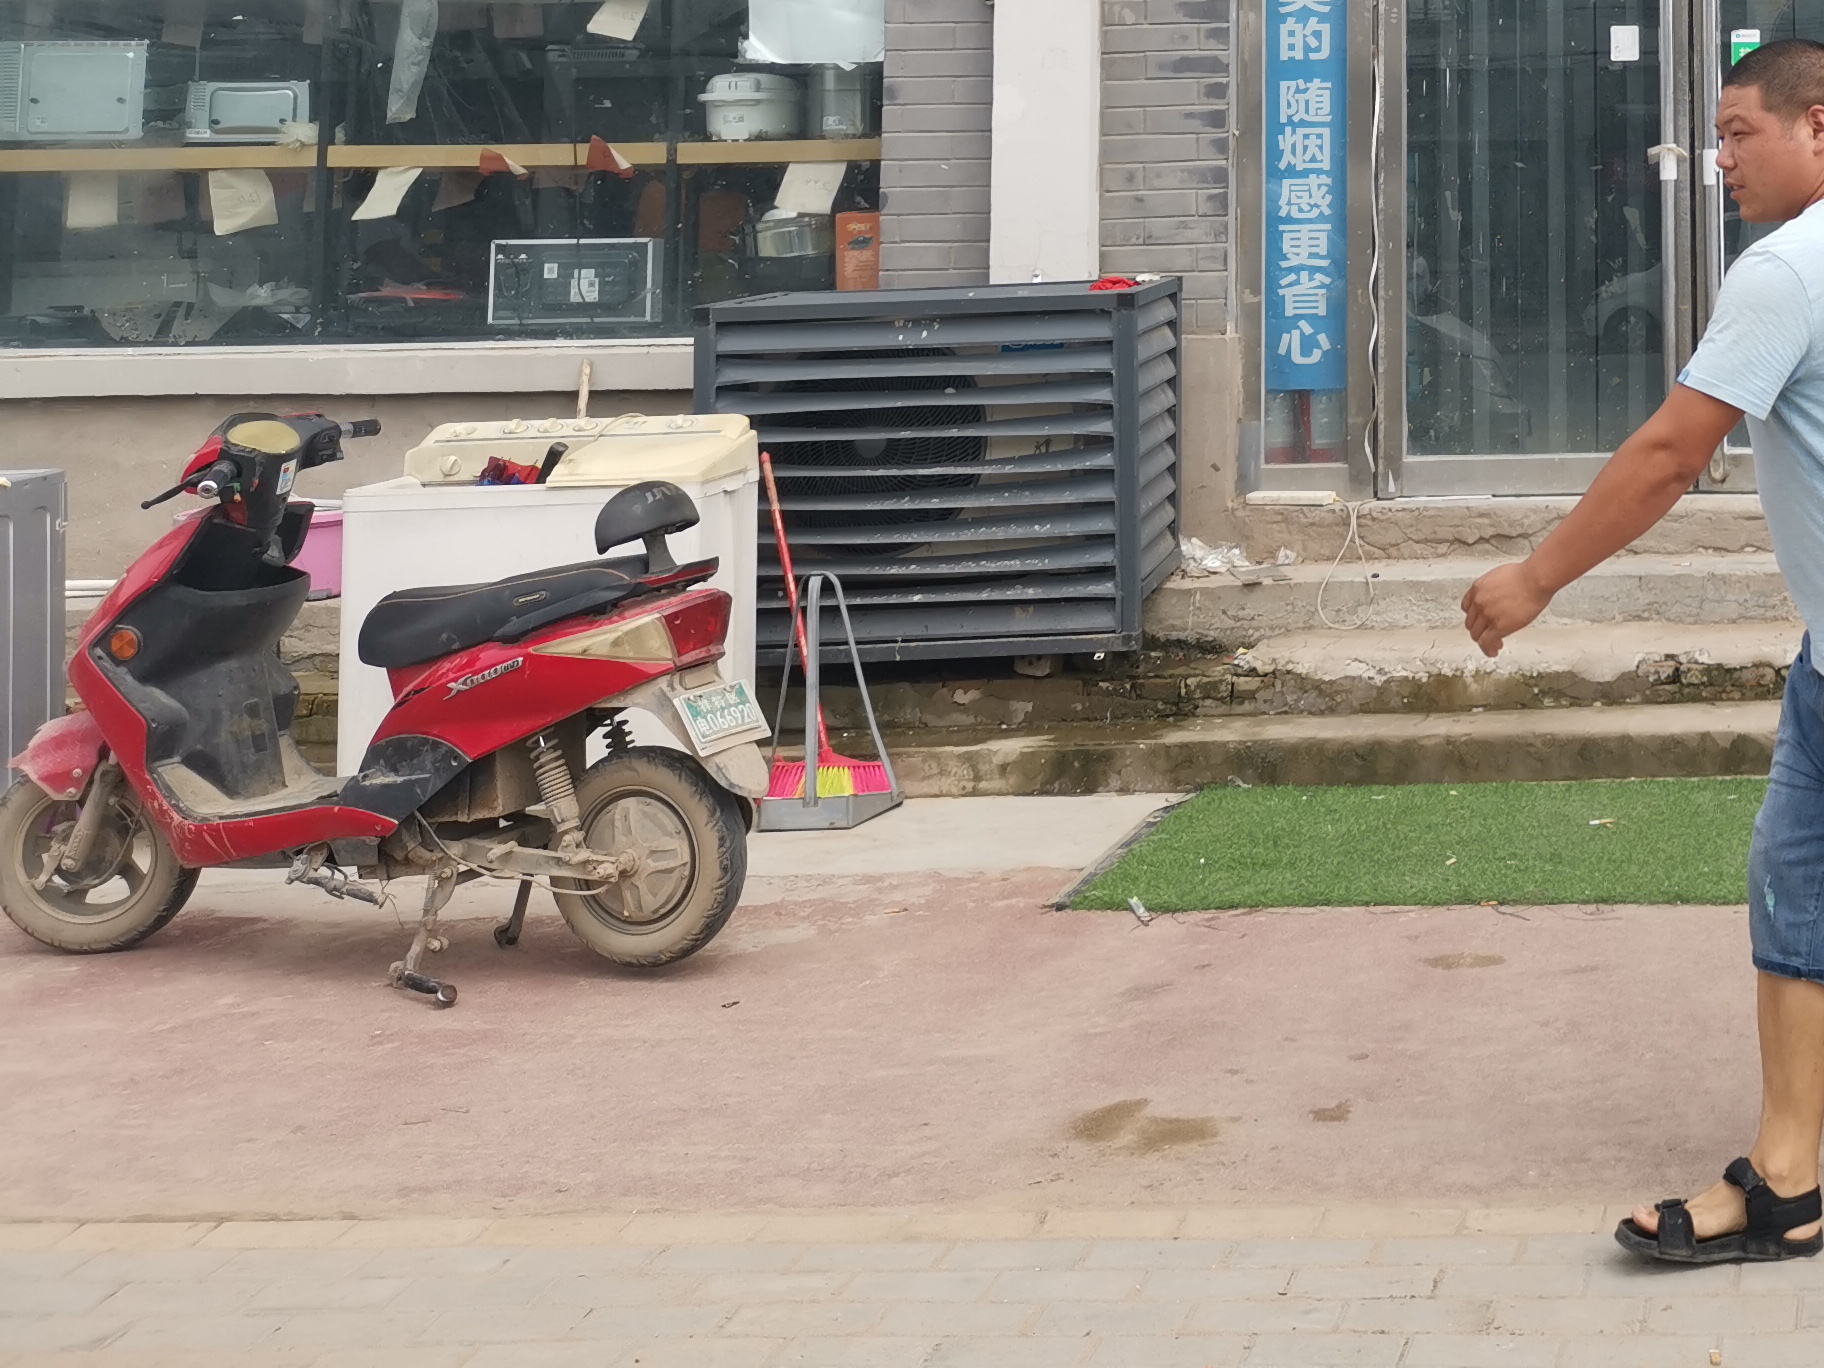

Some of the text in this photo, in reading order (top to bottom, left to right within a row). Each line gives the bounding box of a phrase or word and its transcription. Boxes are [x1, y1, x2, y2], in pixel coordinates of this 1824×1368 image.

[1277, 79, 1332, 366] 随烟感更省心
[695, 702, 757, 736] 电066920
